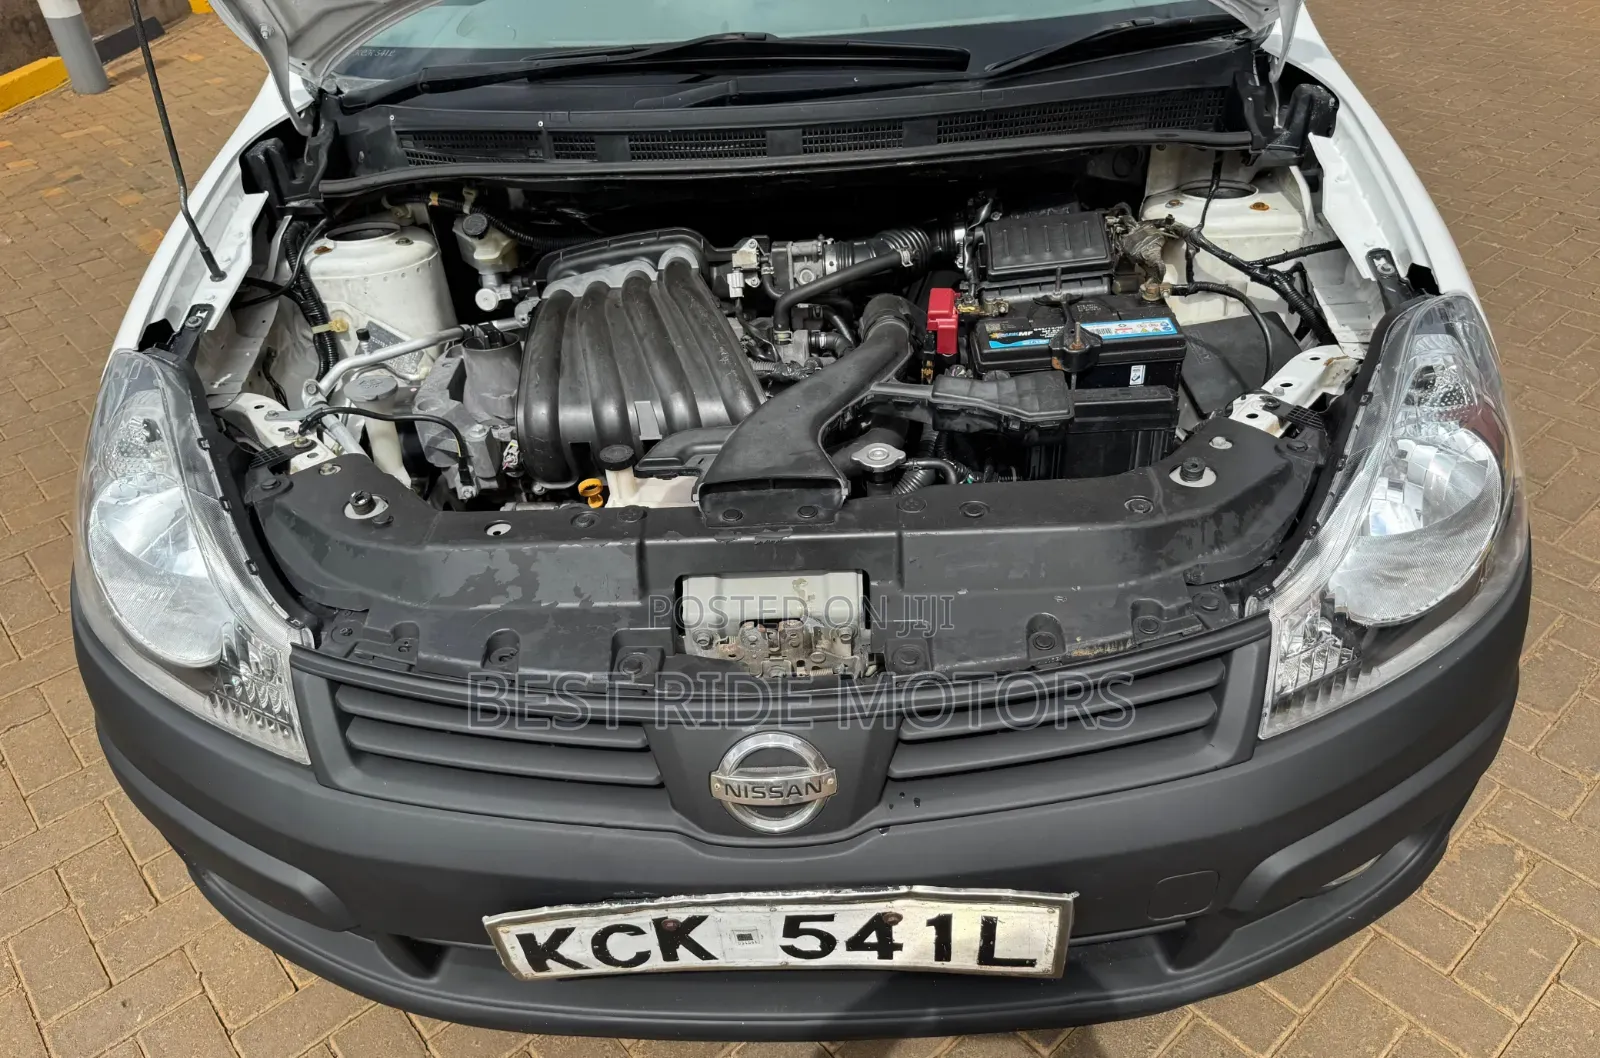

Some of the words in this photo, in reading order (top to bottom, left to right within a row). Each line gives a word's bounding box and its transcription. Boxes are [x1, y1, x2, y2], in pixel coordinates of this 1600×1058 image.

[725, 780, 822, 799] NISSAN
[514, 914, 719, 972] KCK
[778, 912, 1037, 968] 541L
